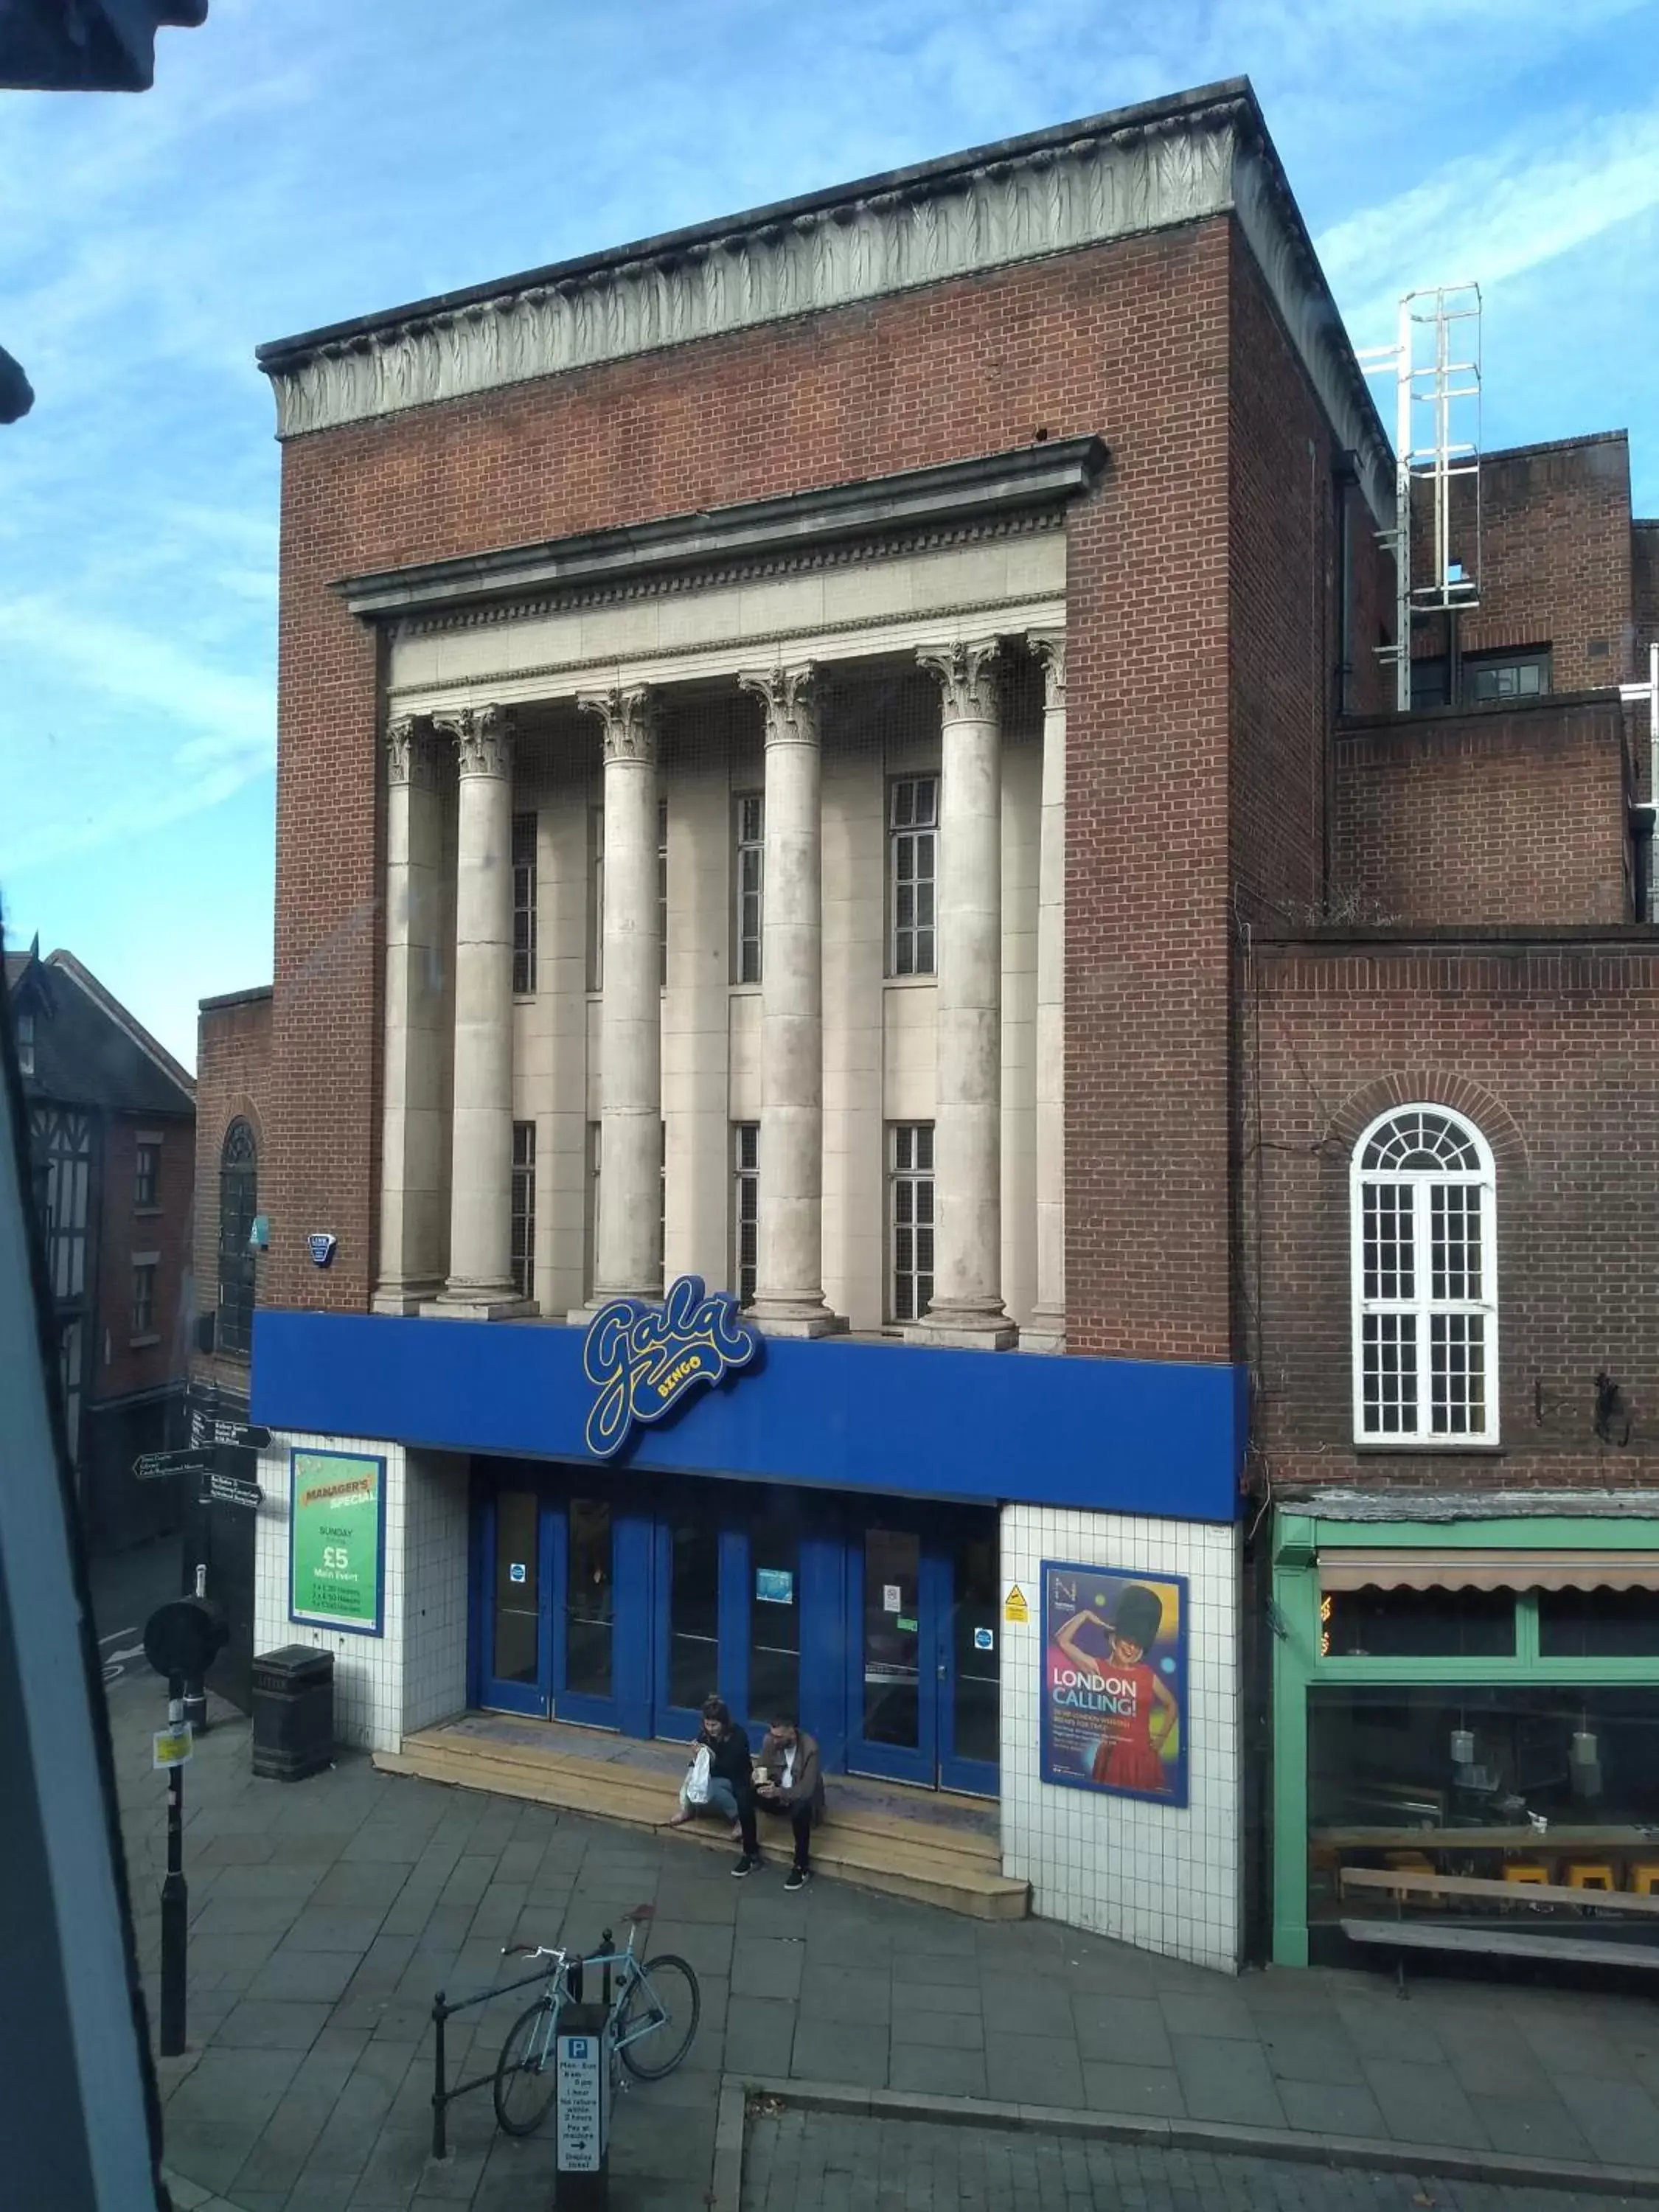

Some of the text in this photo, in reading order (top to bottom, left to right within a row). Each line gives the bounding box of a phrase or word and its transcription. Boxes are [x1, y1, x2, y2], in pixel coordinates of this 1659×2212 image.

[584, 1279, 758, 1456] Gala
[658, 1355, 702, 1397] BINGO
[305, 1478, 369, 1501] MANAGER'S
[330, 1490, 376, 1509] SPECIAL
[319, 1526, 353, 1537] SUNDAY
[323, 1545, 349, 1569] £5
[1054, 1667, 1136, 1698] LONDON
[1052, 1686, 1136, 1717] CALLING!
[573, 2040, 585, 2057] P
